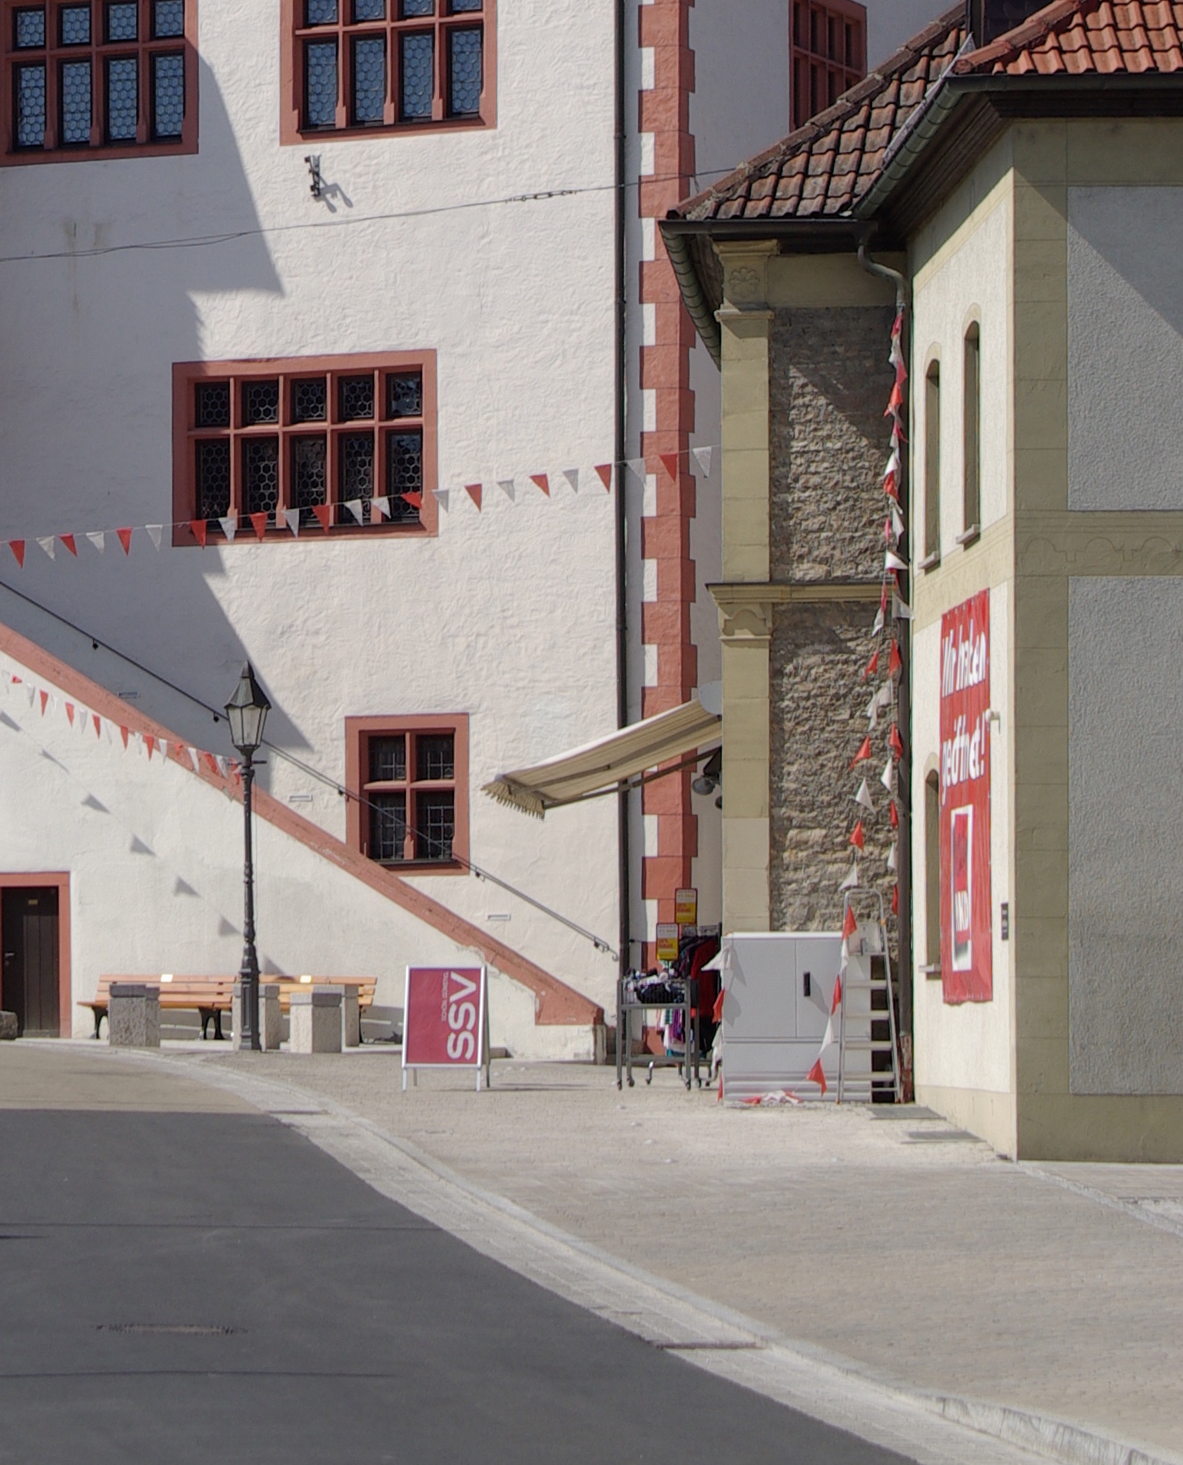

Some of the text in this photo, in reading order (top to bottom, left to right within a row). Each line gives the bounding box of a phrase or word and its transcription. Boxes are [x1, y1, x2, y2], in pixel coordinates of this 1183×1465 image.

[956, 618, 987, 691] haben
[941, 710, 986, 807] geöffnet!
[446, 971, 477, 1061] SSV
